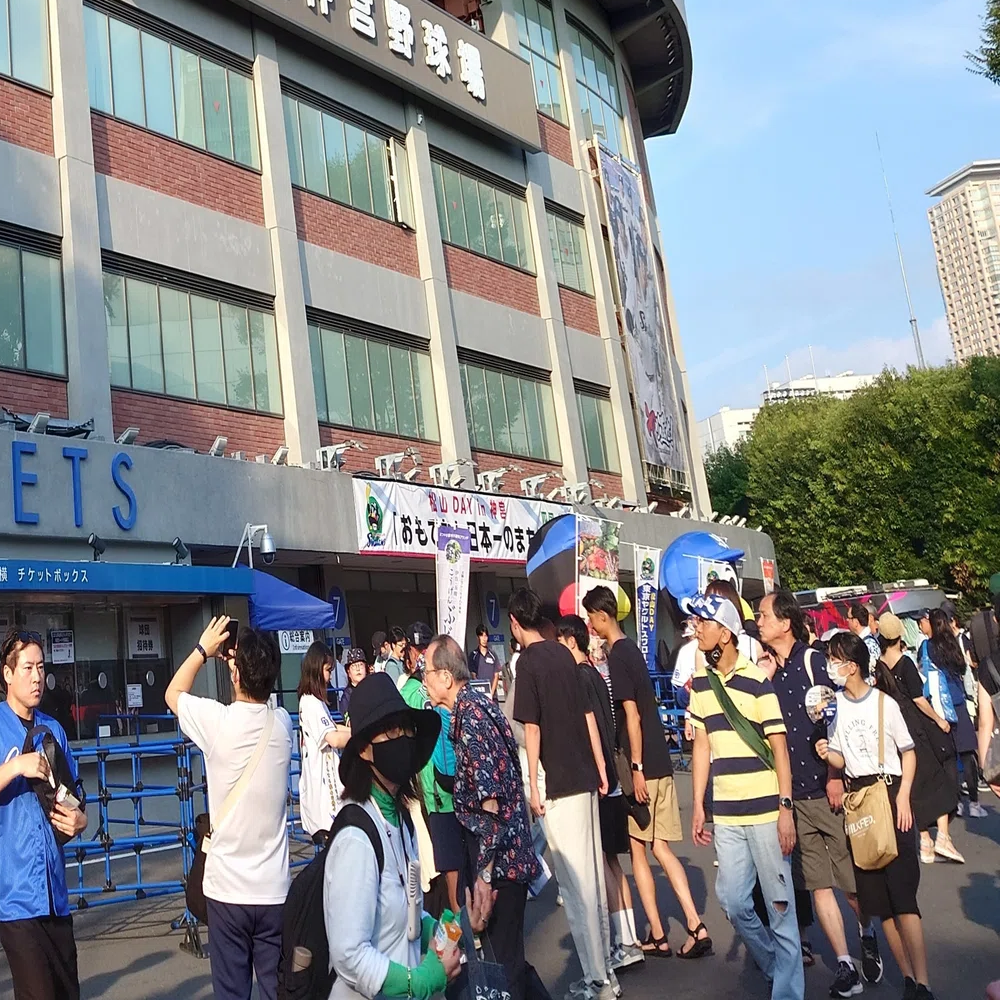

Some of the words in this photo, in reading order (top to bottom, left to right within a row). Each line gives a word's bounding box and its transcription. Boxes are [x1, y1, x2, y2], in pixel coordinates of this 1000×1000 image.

[452, 496, 472, 515] DAY
[18, 567, 89, 582] チケットボックス
[332, 596, 340, 621] 7
[489, 599, 496, 621] 7
